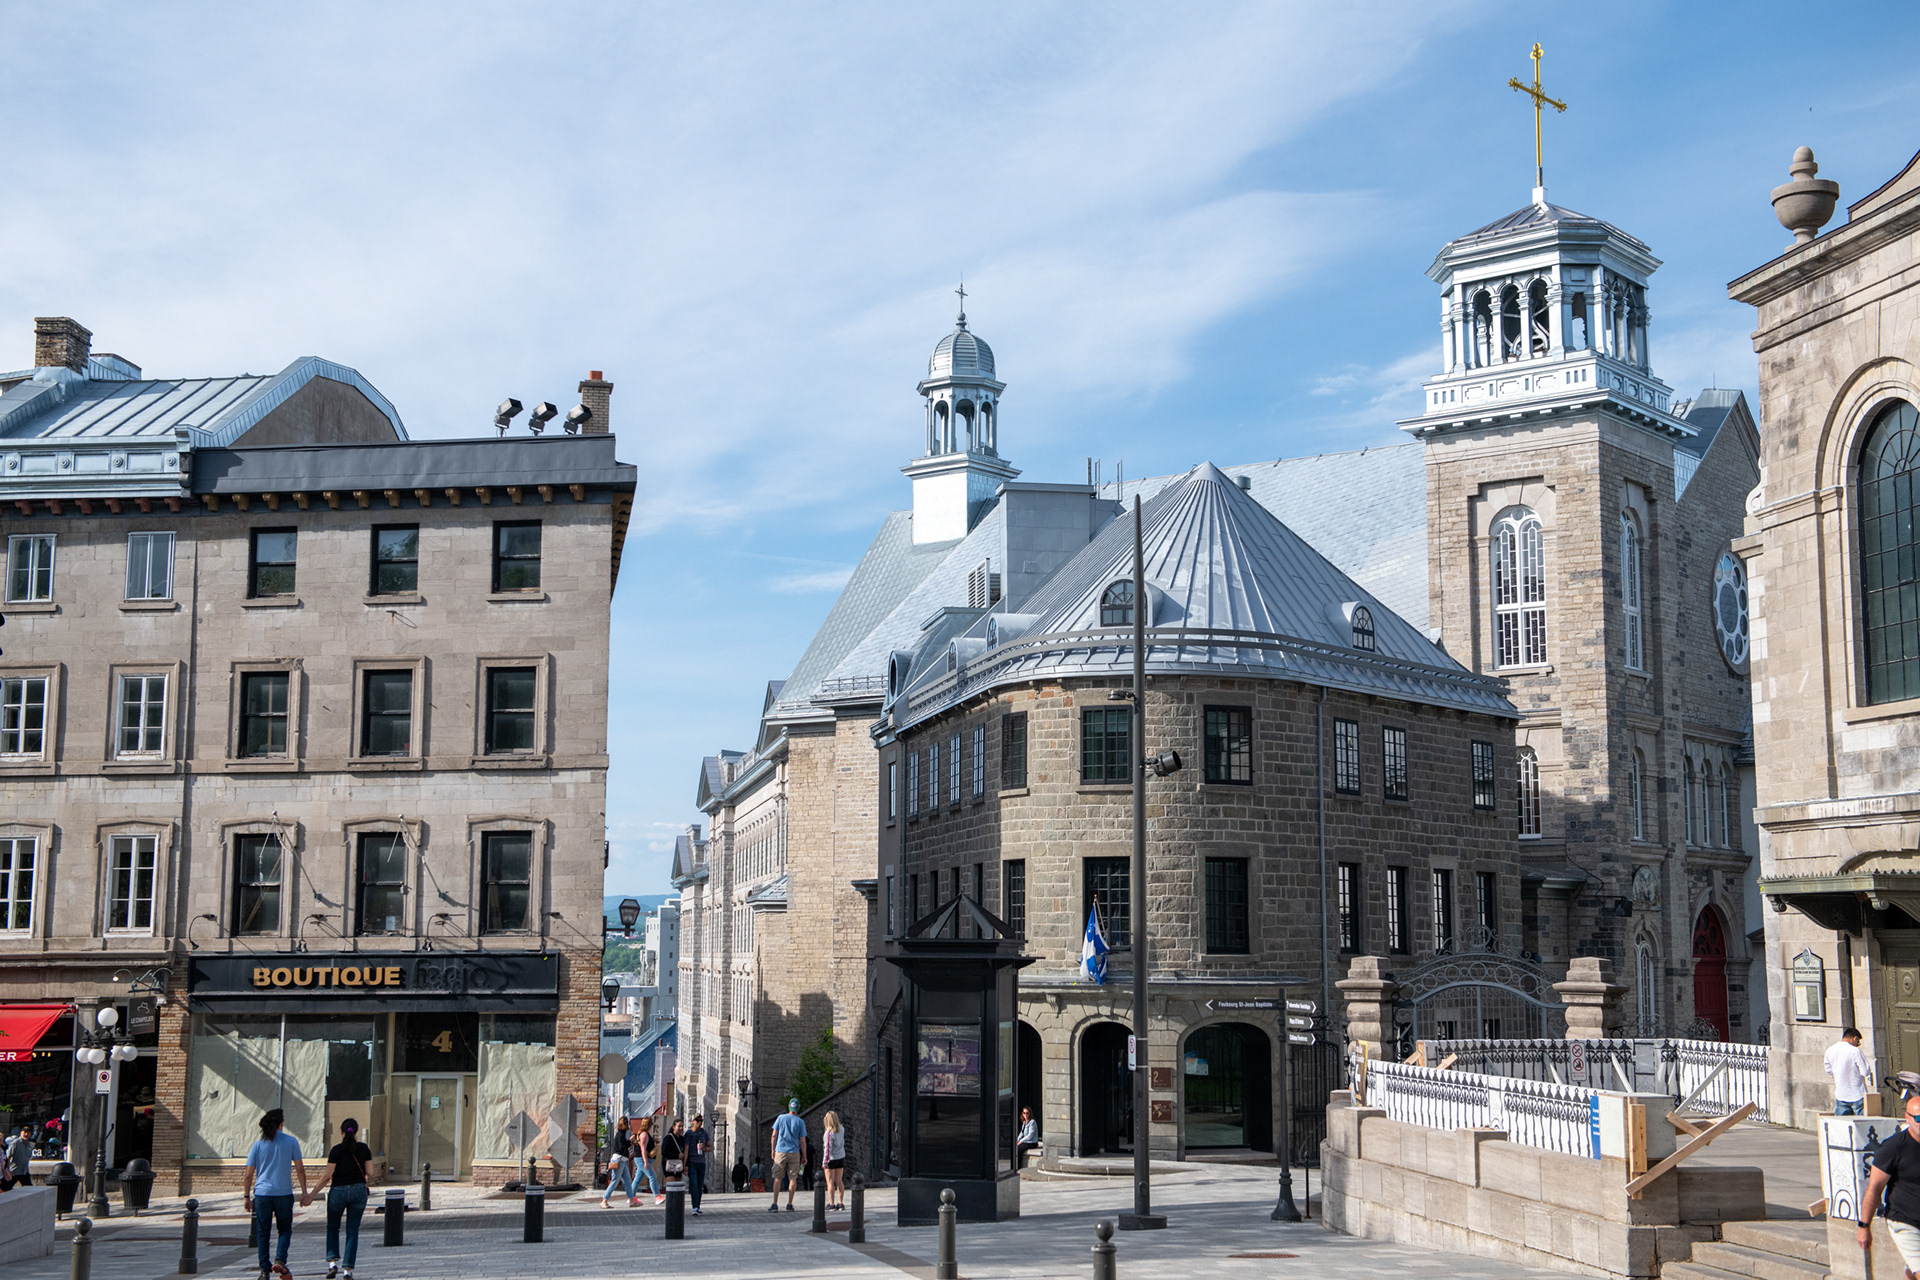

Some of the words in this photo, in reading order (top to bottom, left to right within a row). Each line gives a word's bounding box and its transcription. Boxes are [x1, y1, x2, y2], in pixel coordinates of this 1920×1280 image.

[253, 966, 400, 986] BOUTIQUE
[431, 1030, 453, 1052] 4
[1153, 1070, 1159, 1083] 2
